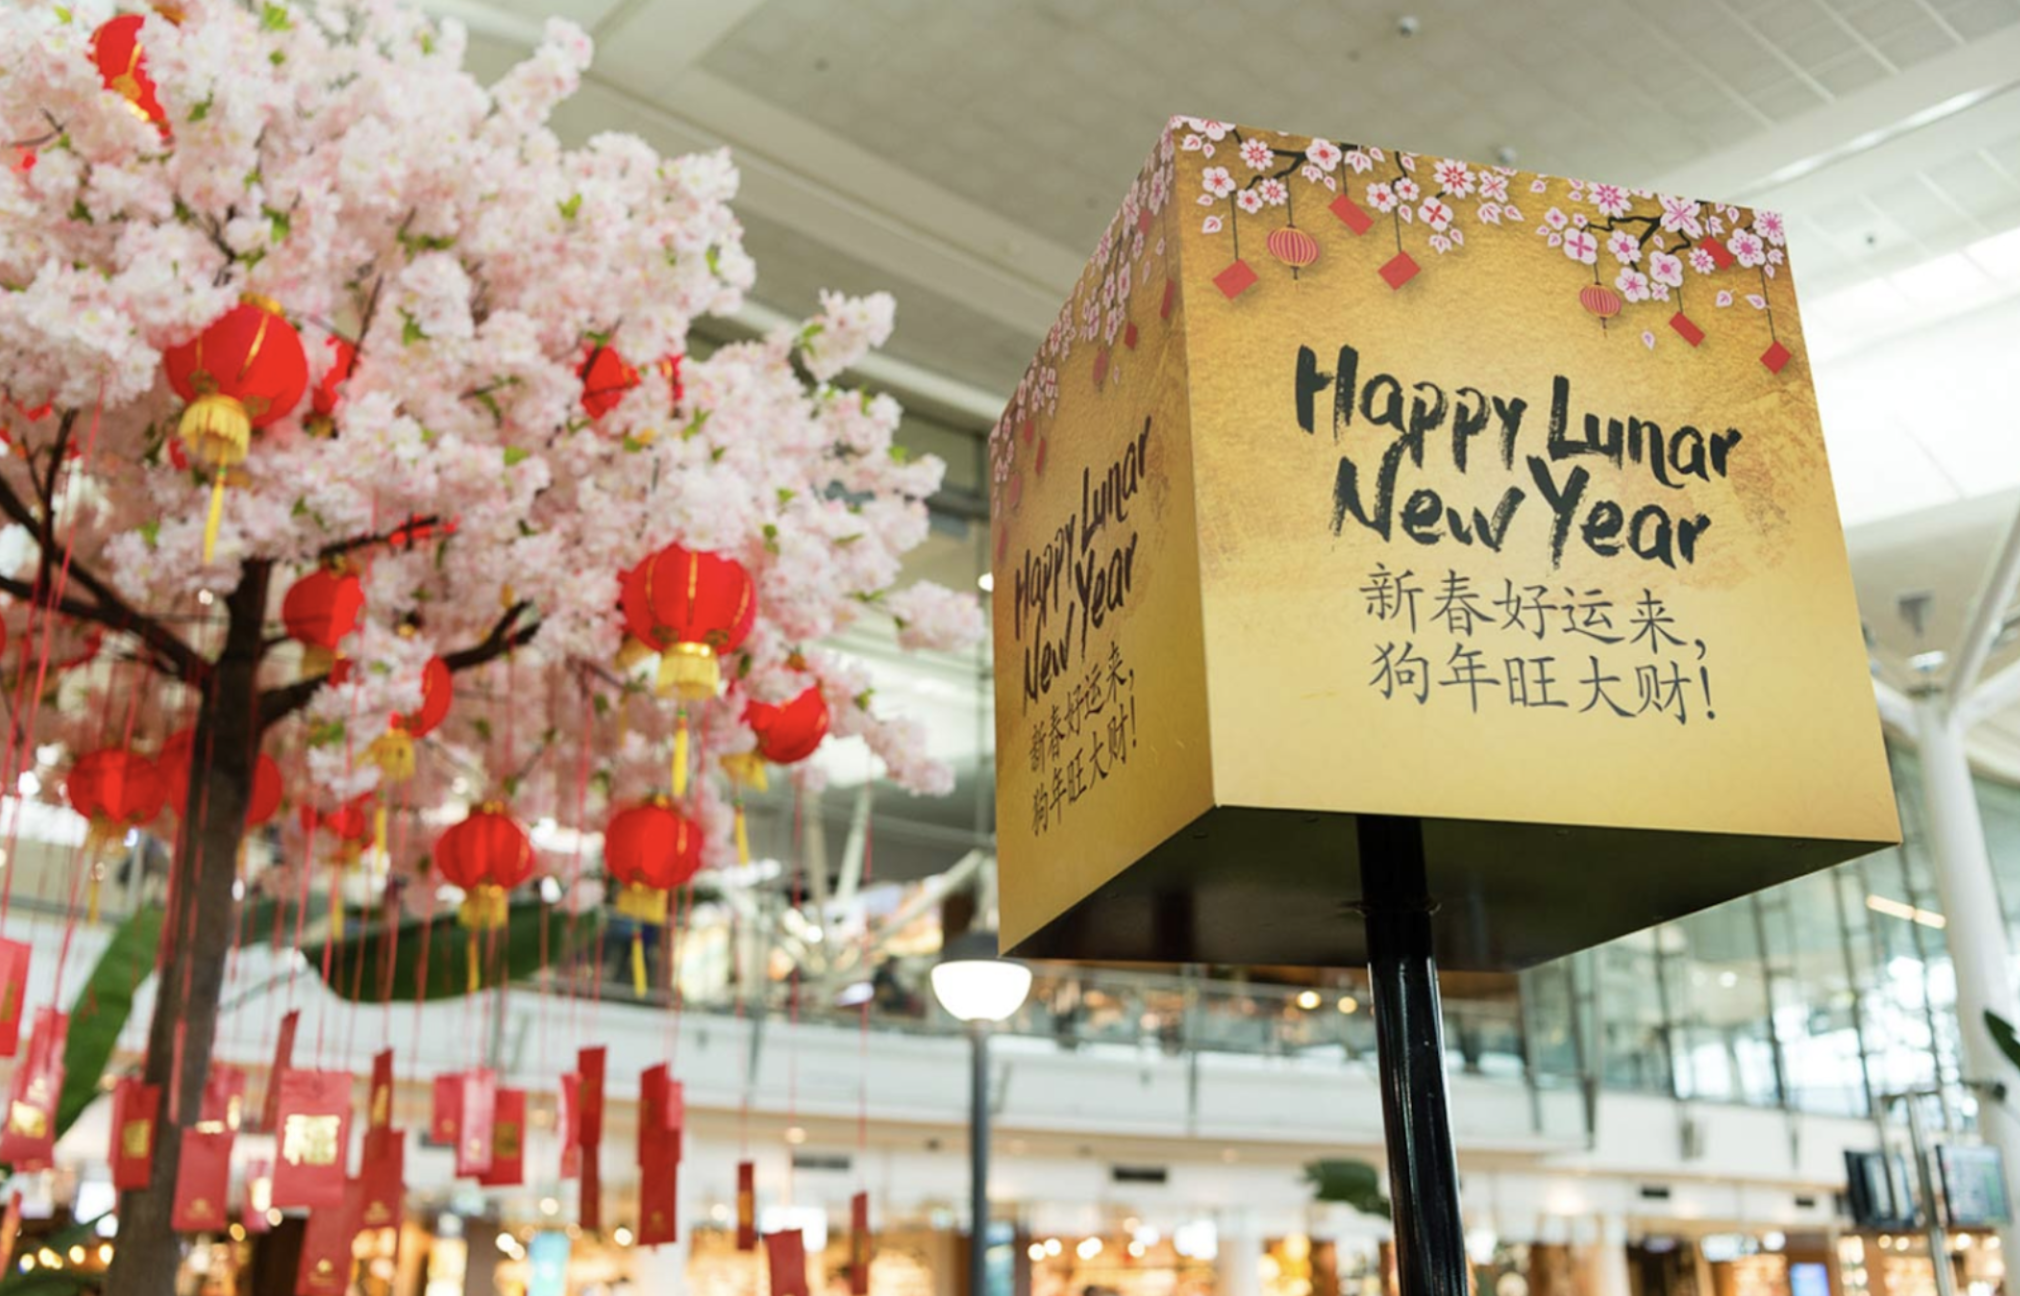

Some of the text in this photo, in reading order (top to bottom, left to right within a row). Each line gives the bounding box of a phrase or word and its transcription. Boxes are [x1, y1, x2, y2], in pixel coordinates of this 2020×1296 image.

[1294, 345, 1743, 489] Happy Lunar
[1014, 415, 1152, 641] Happy Lunar
[1329, 431, 1712, 571] New Year
[1023, 531, 1138, 716] New Year
